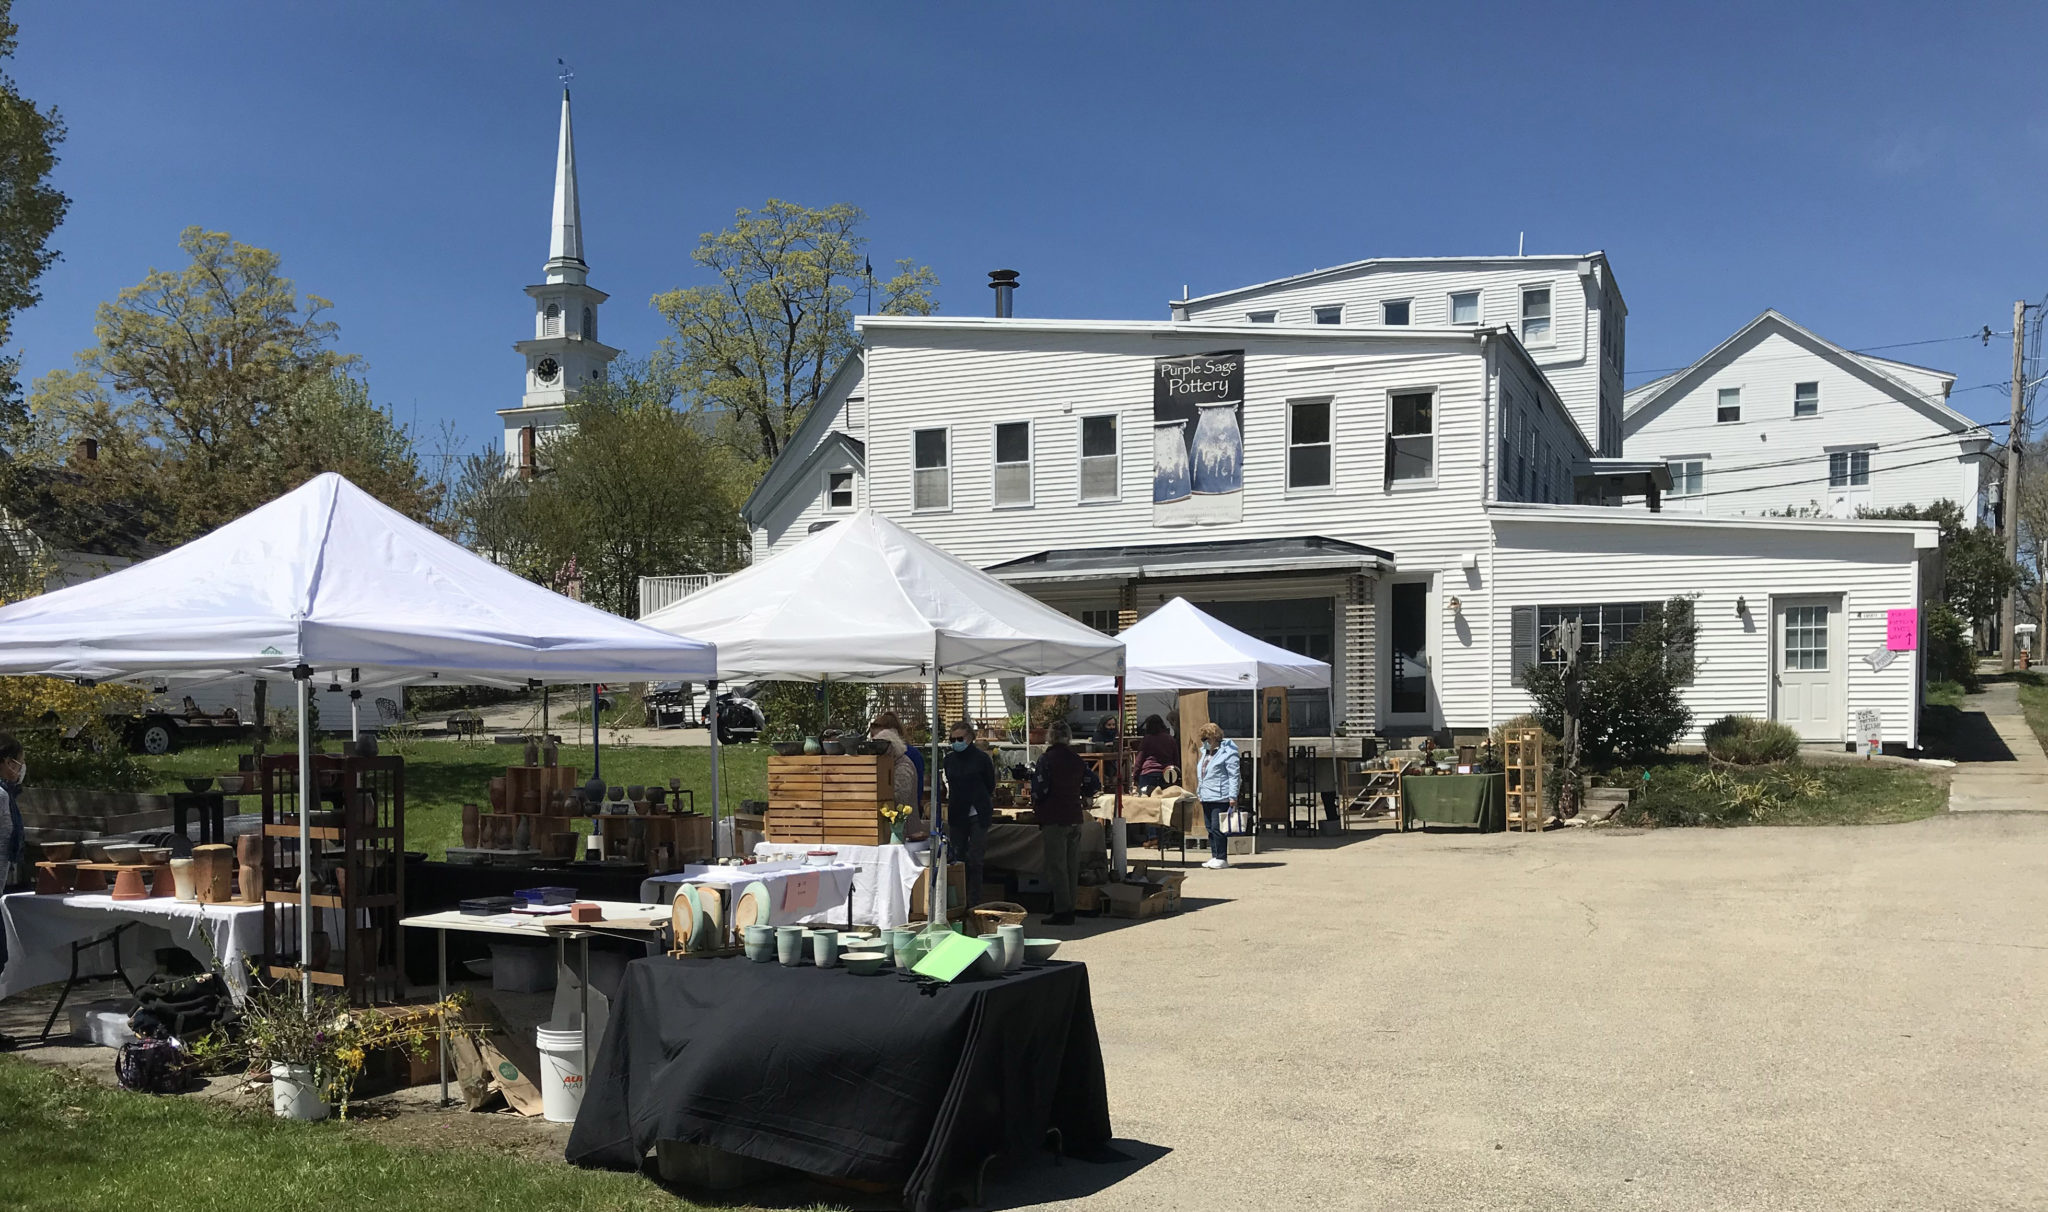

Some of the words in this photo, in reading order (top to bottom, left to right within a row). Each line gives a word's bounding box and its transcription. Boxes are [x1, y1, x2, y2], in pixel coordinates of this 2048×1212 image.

[1161, 358, 1201, 381] Purple
[1203, 359, 1238, 377] Sage
[1169, 378, 1229, 399] Pottery
